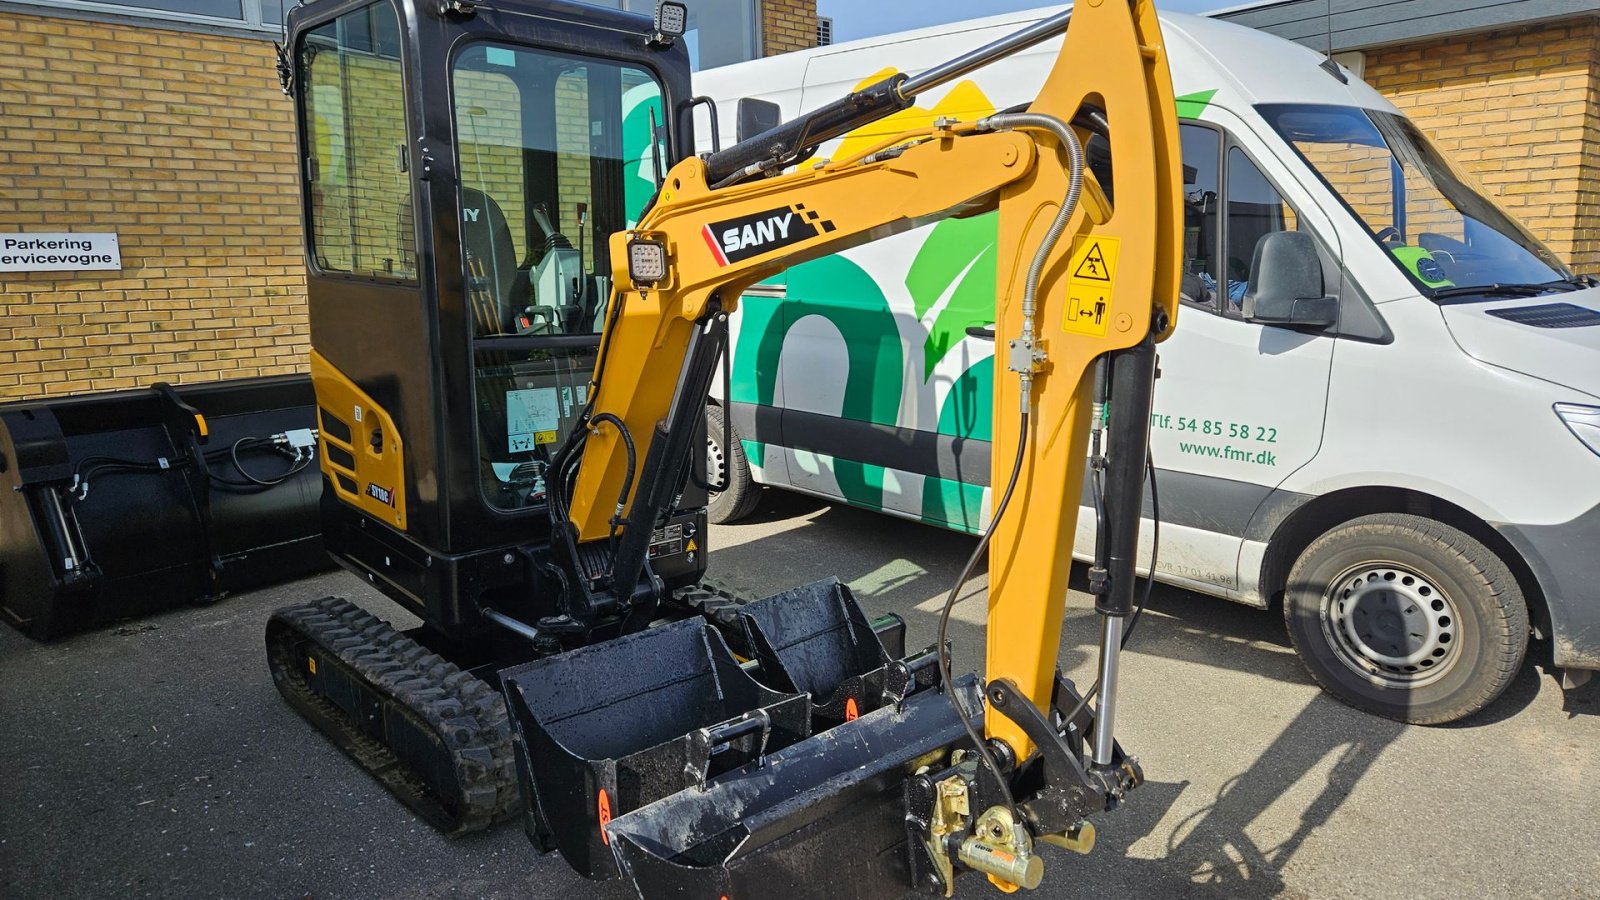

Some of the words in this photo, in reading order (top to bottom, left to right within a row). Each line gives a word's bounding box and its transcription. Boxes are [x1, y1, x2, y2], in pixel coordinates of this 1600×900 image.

[722, 212, 793, 253] SANY
[4, 238, 92, 251] Parkering
[0, 253, 112, 265] ervicevogne
[1151, 414, 1173, 429] Tlf.
[1177, 417, 1197, 432] 54
[1202, 420, 1222, 436] 85
[1228, 423, 1249, 439] 58
[1255, 426, 1277, 443] 22
[1179, 441, 1276, 466] www.fmr.dk
[1220, 575, 1232, 585] 96
